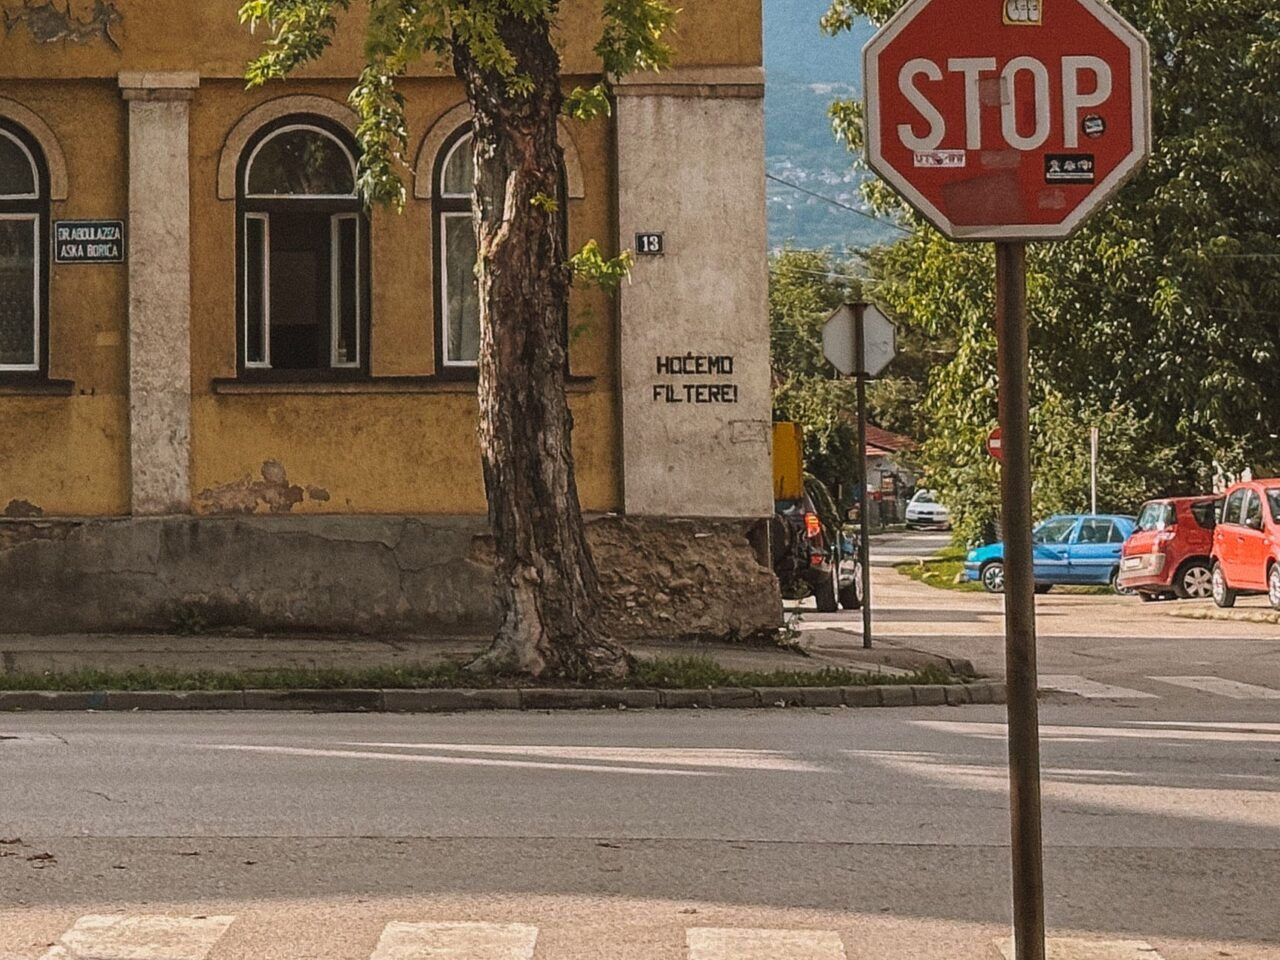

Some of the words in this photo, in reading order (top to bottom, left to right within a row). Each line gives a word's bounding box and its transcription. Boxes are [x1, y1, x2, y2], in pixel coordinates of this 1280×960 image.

[897, 56, 1112, 151] STOP
[61, 244, 84, 257] ASKA
[641, 236, 659, 251] 13
[653, 385, 738, 403] FILTERE!
